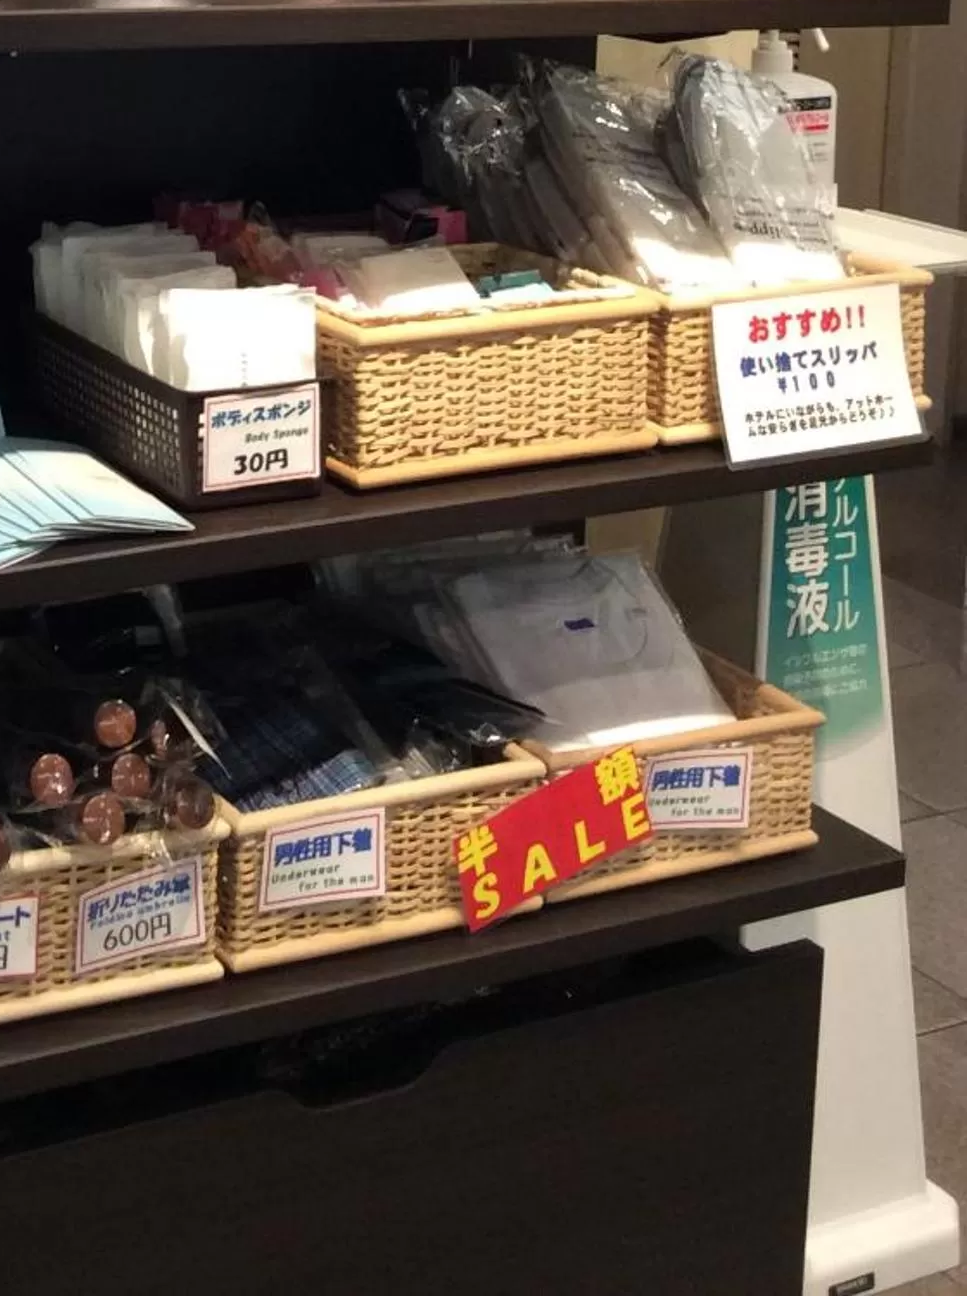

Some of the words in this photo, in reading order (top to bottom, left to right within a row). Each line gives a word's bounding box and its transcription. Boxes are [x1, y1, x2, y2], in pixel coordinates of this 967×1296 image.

[740, 341, 878, 377] 使い捨てスリッパ
[211, 399, 312, 429] ボディスポンジ
[245, 432, 270, 444] Body
[273, 427, 309, 441] Sponge
[233, 448, 289, 475] 30円
[671, 807, 690, 816] for
[694, 807, 713, 816] the
[472, 793, 651, 920] SALE
[271, 863, 341, 885] Underwear
[298, 881, 319, 893] for
[323, 877, 344, 889] the
[103, 912, 172, 951] 600円
